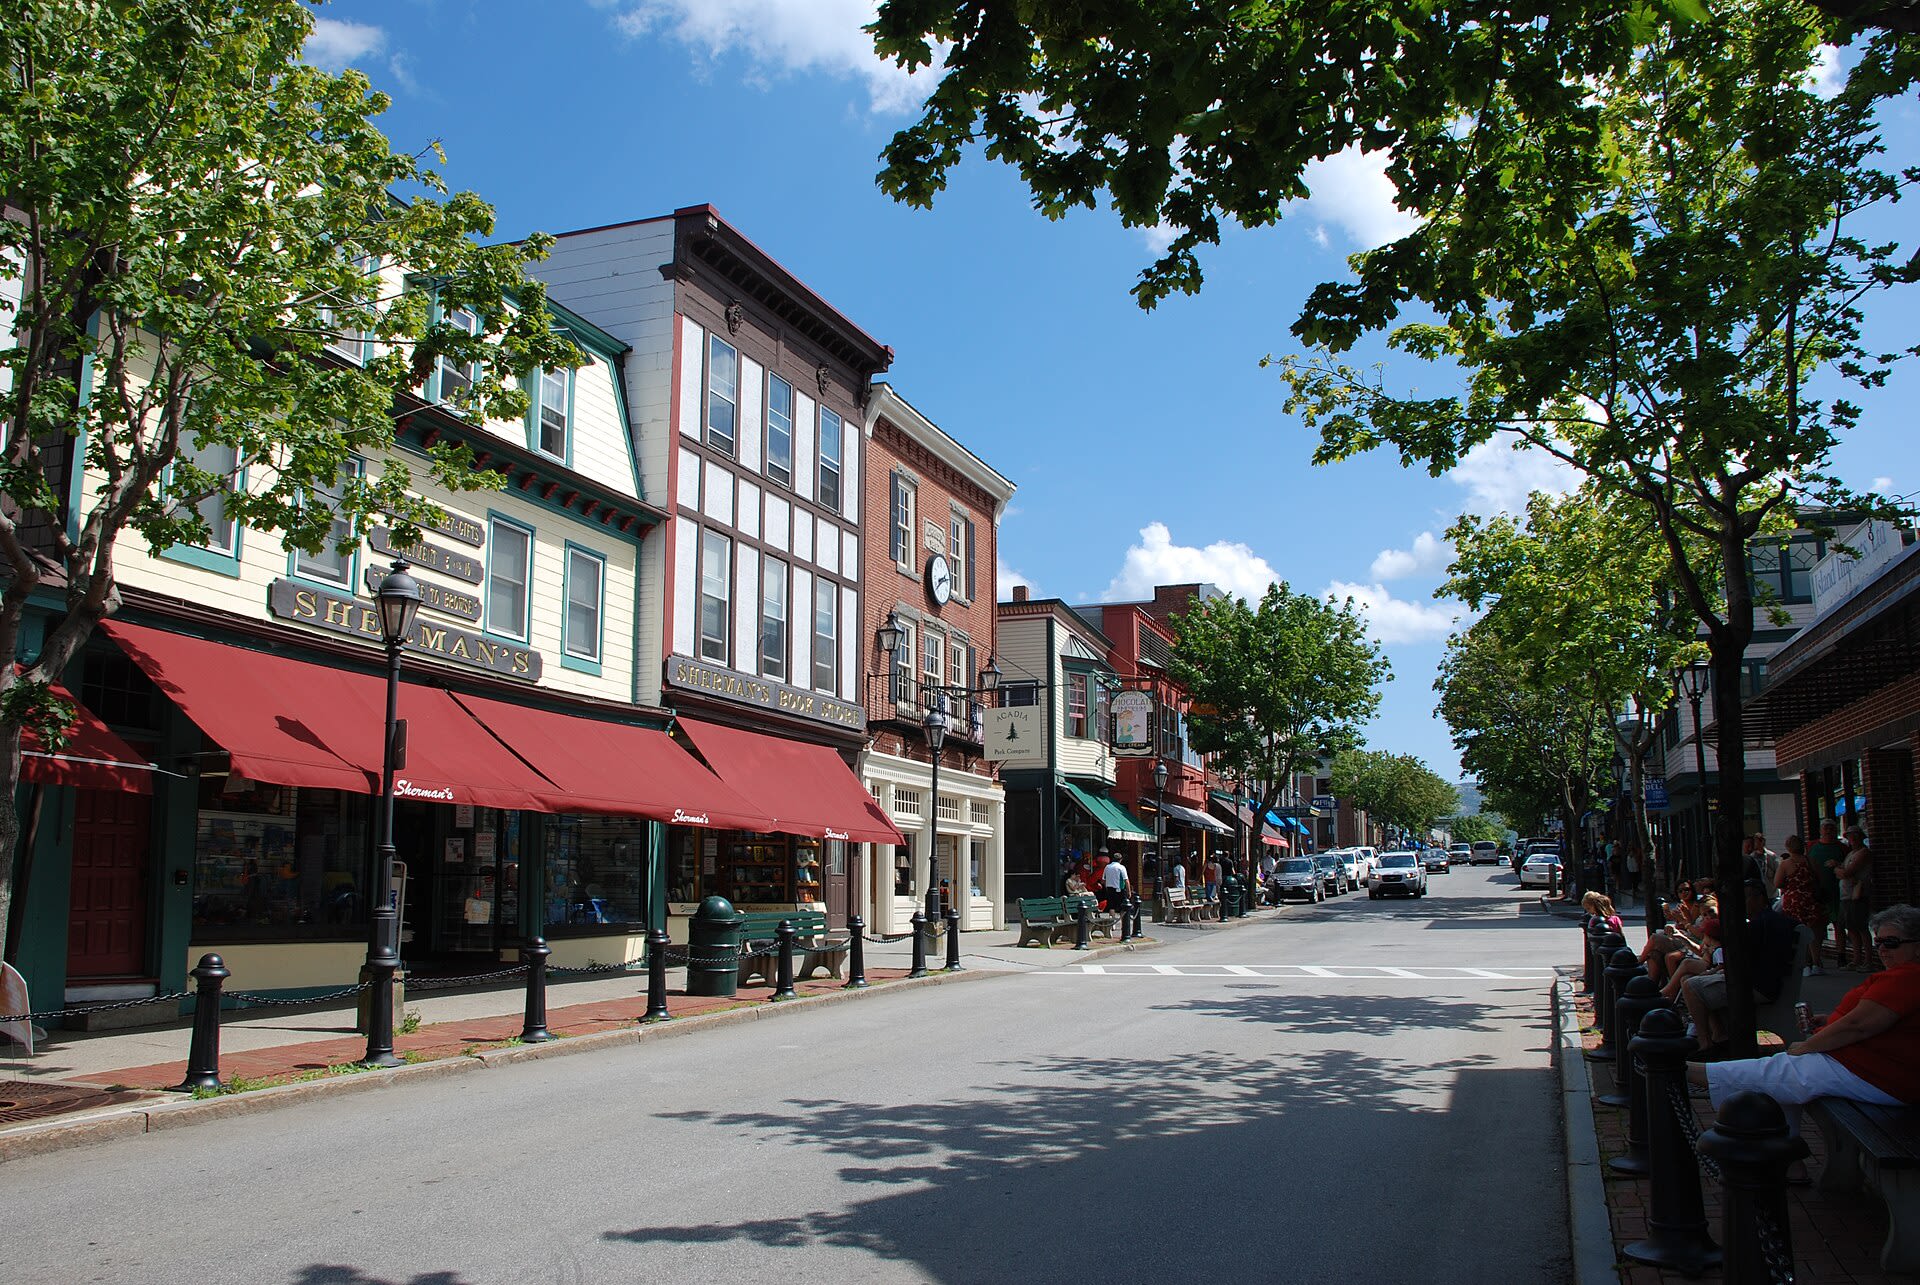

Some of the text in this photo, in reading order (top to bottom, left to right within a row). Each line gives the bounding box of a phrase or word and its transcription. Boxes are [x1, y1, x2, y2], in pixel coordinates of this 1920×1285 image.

[430, 587, 440, 605] TO
[291, 591, 529, 674] SHEMAN'S
[676, 664, 860, 725] SHERMAN'S BOOK STORE
[996, 711, 1029, 722] ACADIA
[393, 780, 454, 800] Sherman's
[670, 808, 709, 825] Sherman's
